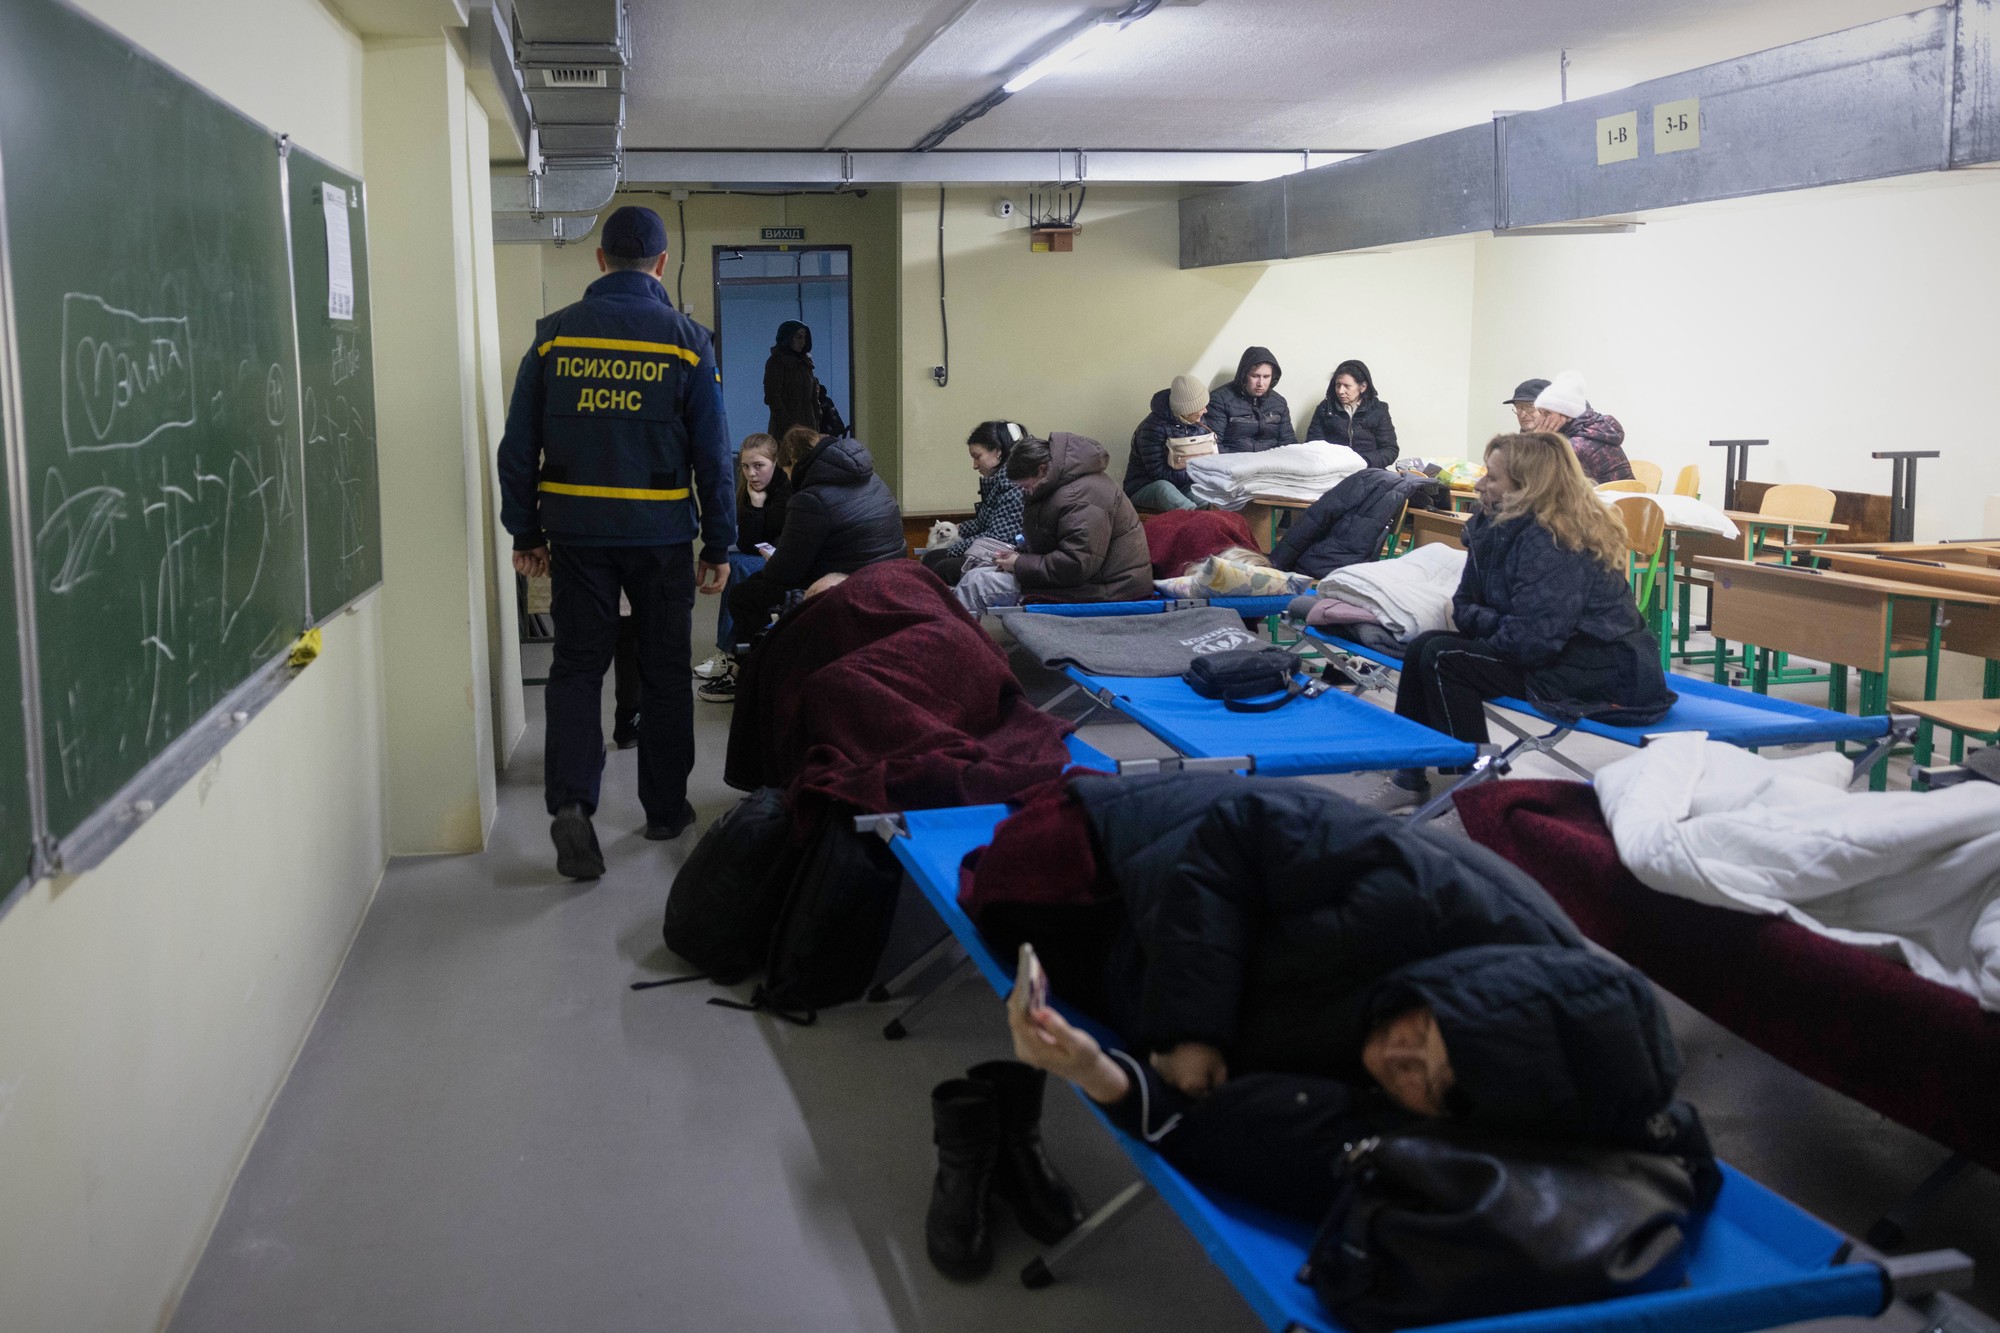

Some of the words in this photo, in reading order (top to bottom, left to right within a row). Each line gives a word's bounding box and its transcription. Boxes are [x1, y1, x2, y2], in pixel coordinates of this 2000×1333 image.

[1665, 113, 1688, 134] 3-Б
[1607, 126, 1627, 146] 1-В
[765, 229, 801, 239] ВИХІД
[556, 357, 670, 382] ПСИХОЛОГ
[577, 387, 642, 412] ДСНС
